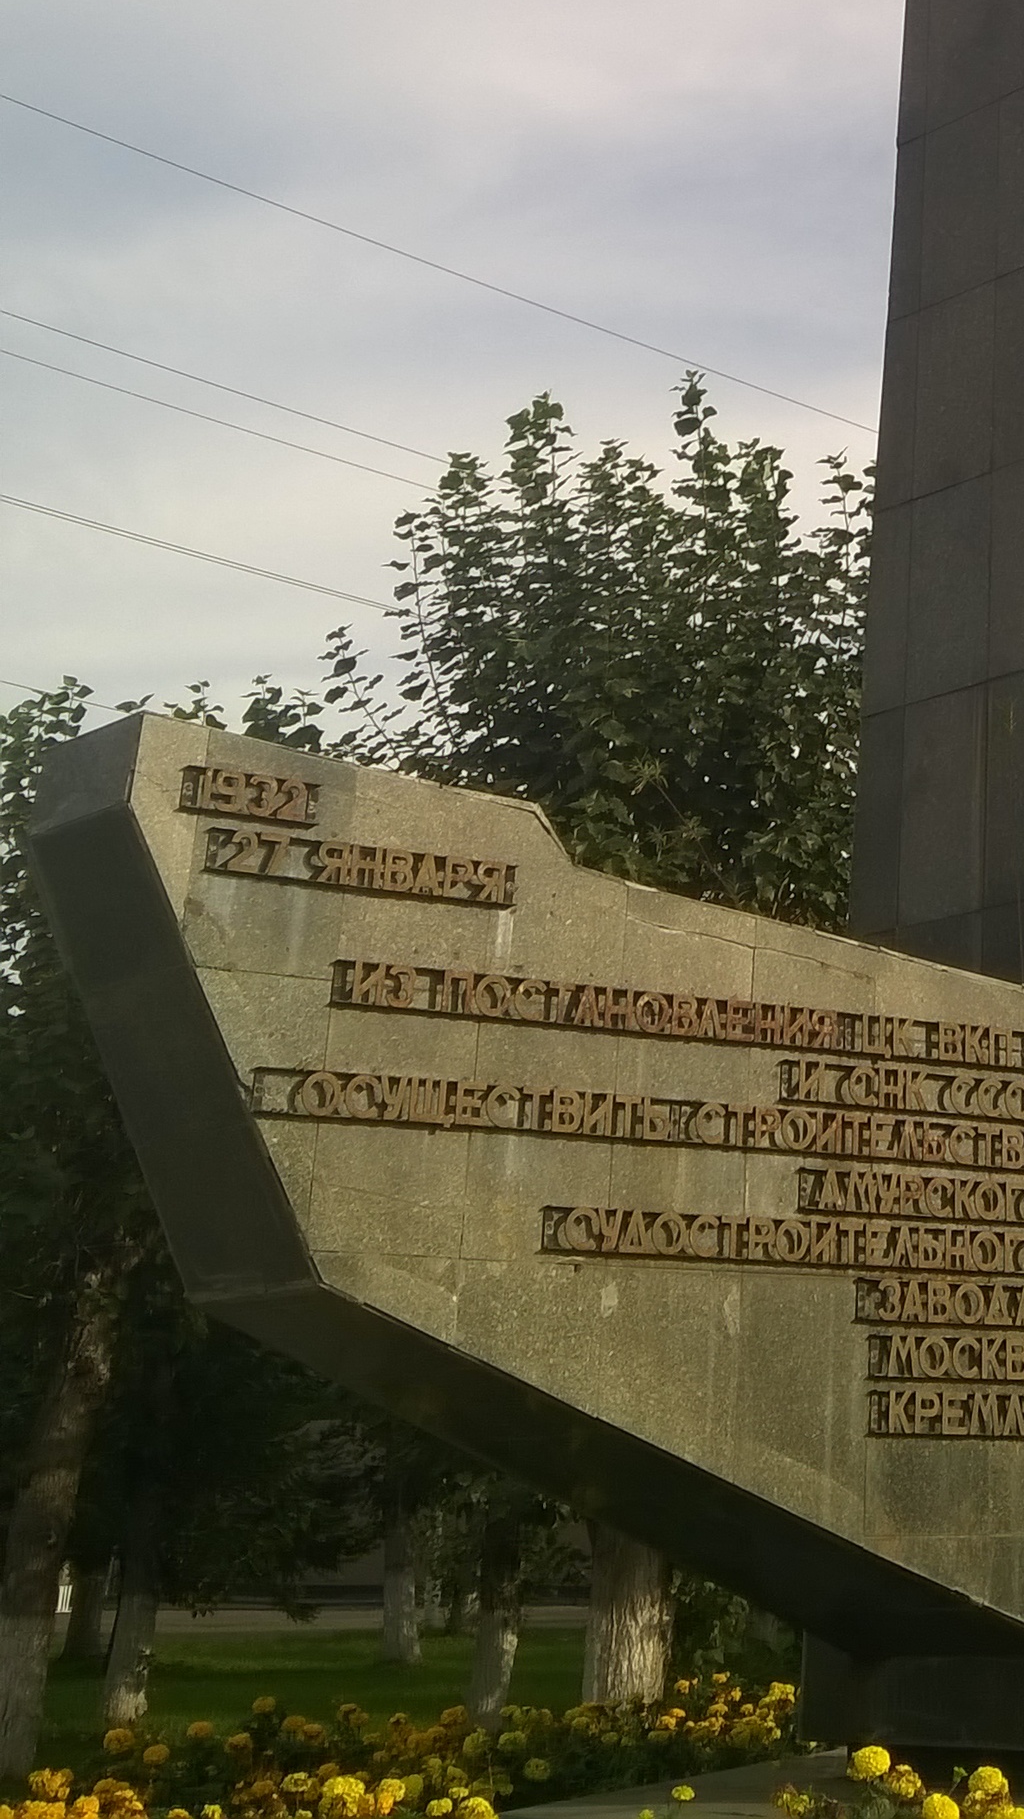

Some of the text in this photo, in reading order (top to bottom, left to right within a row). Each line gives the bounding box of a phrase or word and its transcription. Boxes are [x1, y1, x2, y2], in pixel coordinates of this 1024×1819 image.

[201, 766, 308, 820] 1932
[224, 830, 508, 905] 27 ЯНВАРЯ
[352, 959, 419, 1008] ИЗ
[440, 968, 838, 1051] ПОСТАНОВЛЕНИЯ
[861, 1014, 918, 1060] ЦК
[302, 1071, 674, 1142] ОСУЩЕСТВИТЬ
[800, 1060, 828, 1103] И
[849, 1066, 926, 1112] СНК
